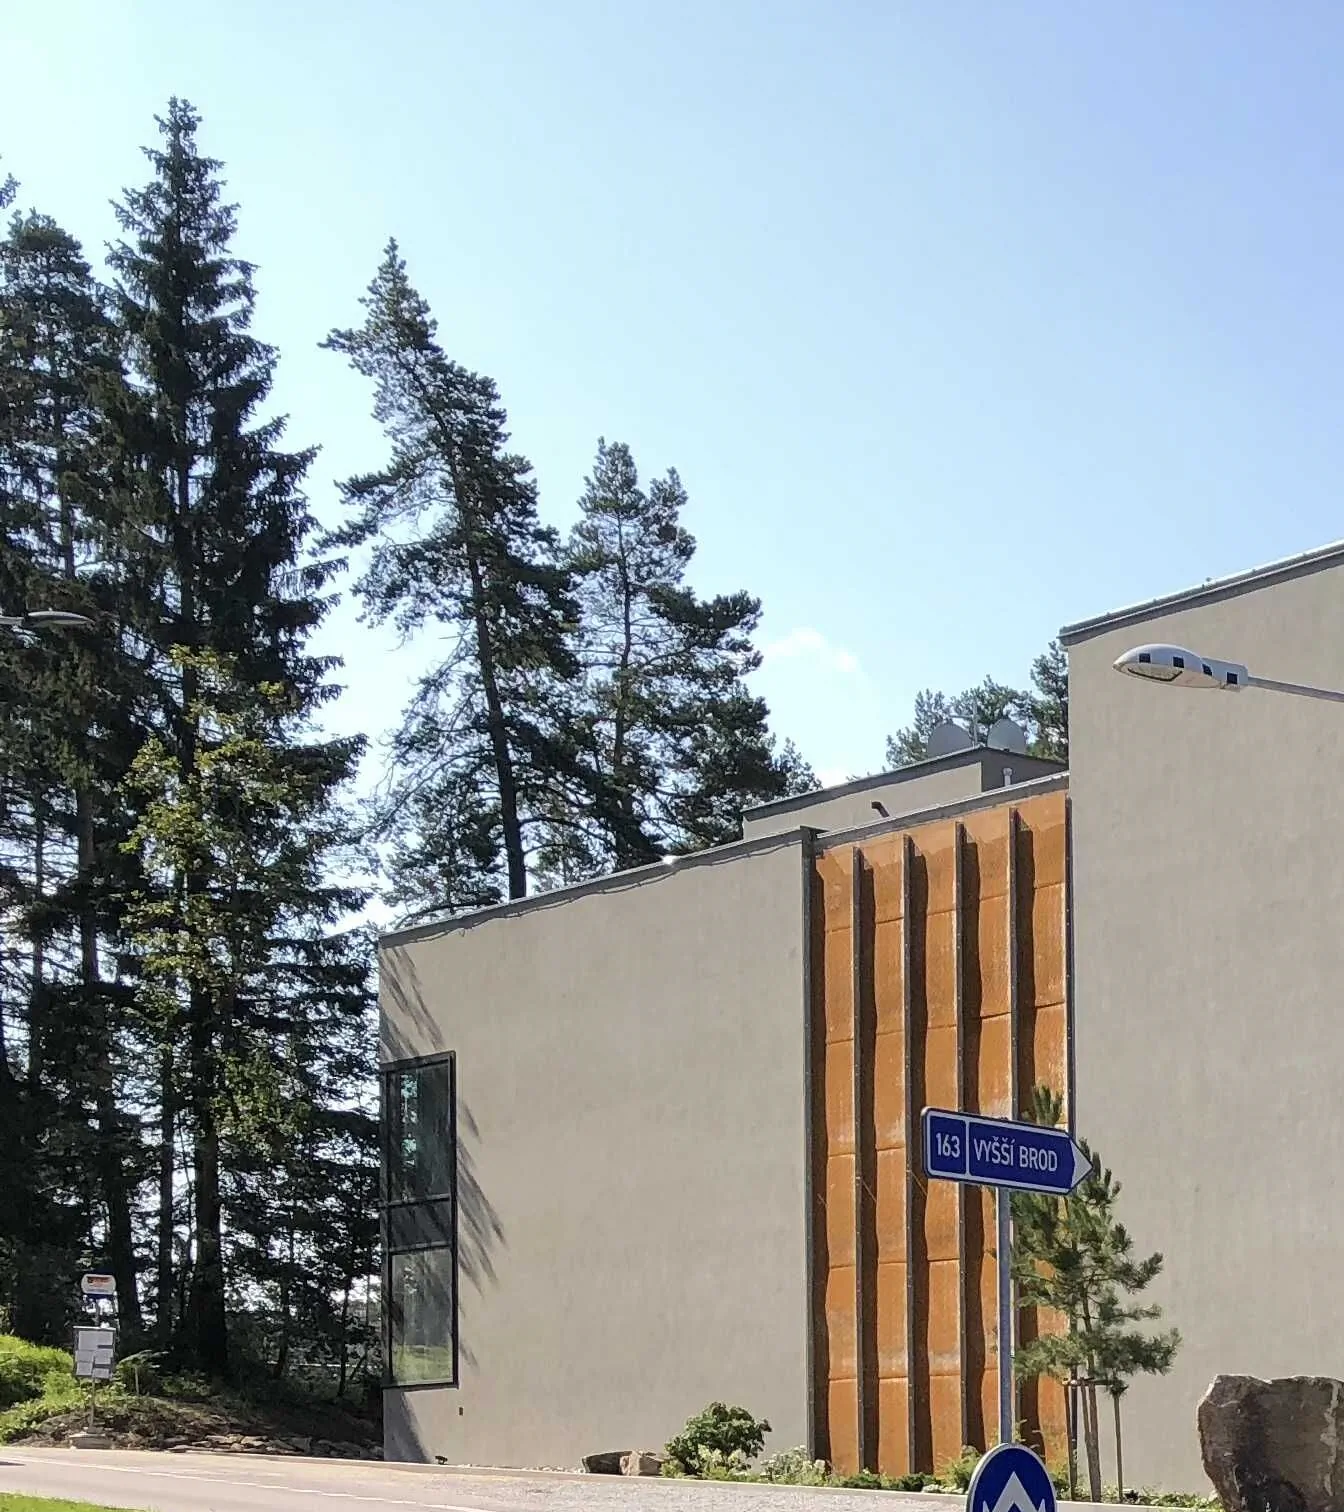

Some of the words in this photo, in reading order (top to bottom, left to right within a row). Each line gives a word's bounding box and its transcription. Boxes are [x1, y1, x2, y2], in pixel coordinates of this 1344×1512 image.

[935, 1132, 961, 1159] 163
[973, 1135, 1016, 1167] VYŠŠÍ
[1019, 1145, 1058, 1172] BROD
